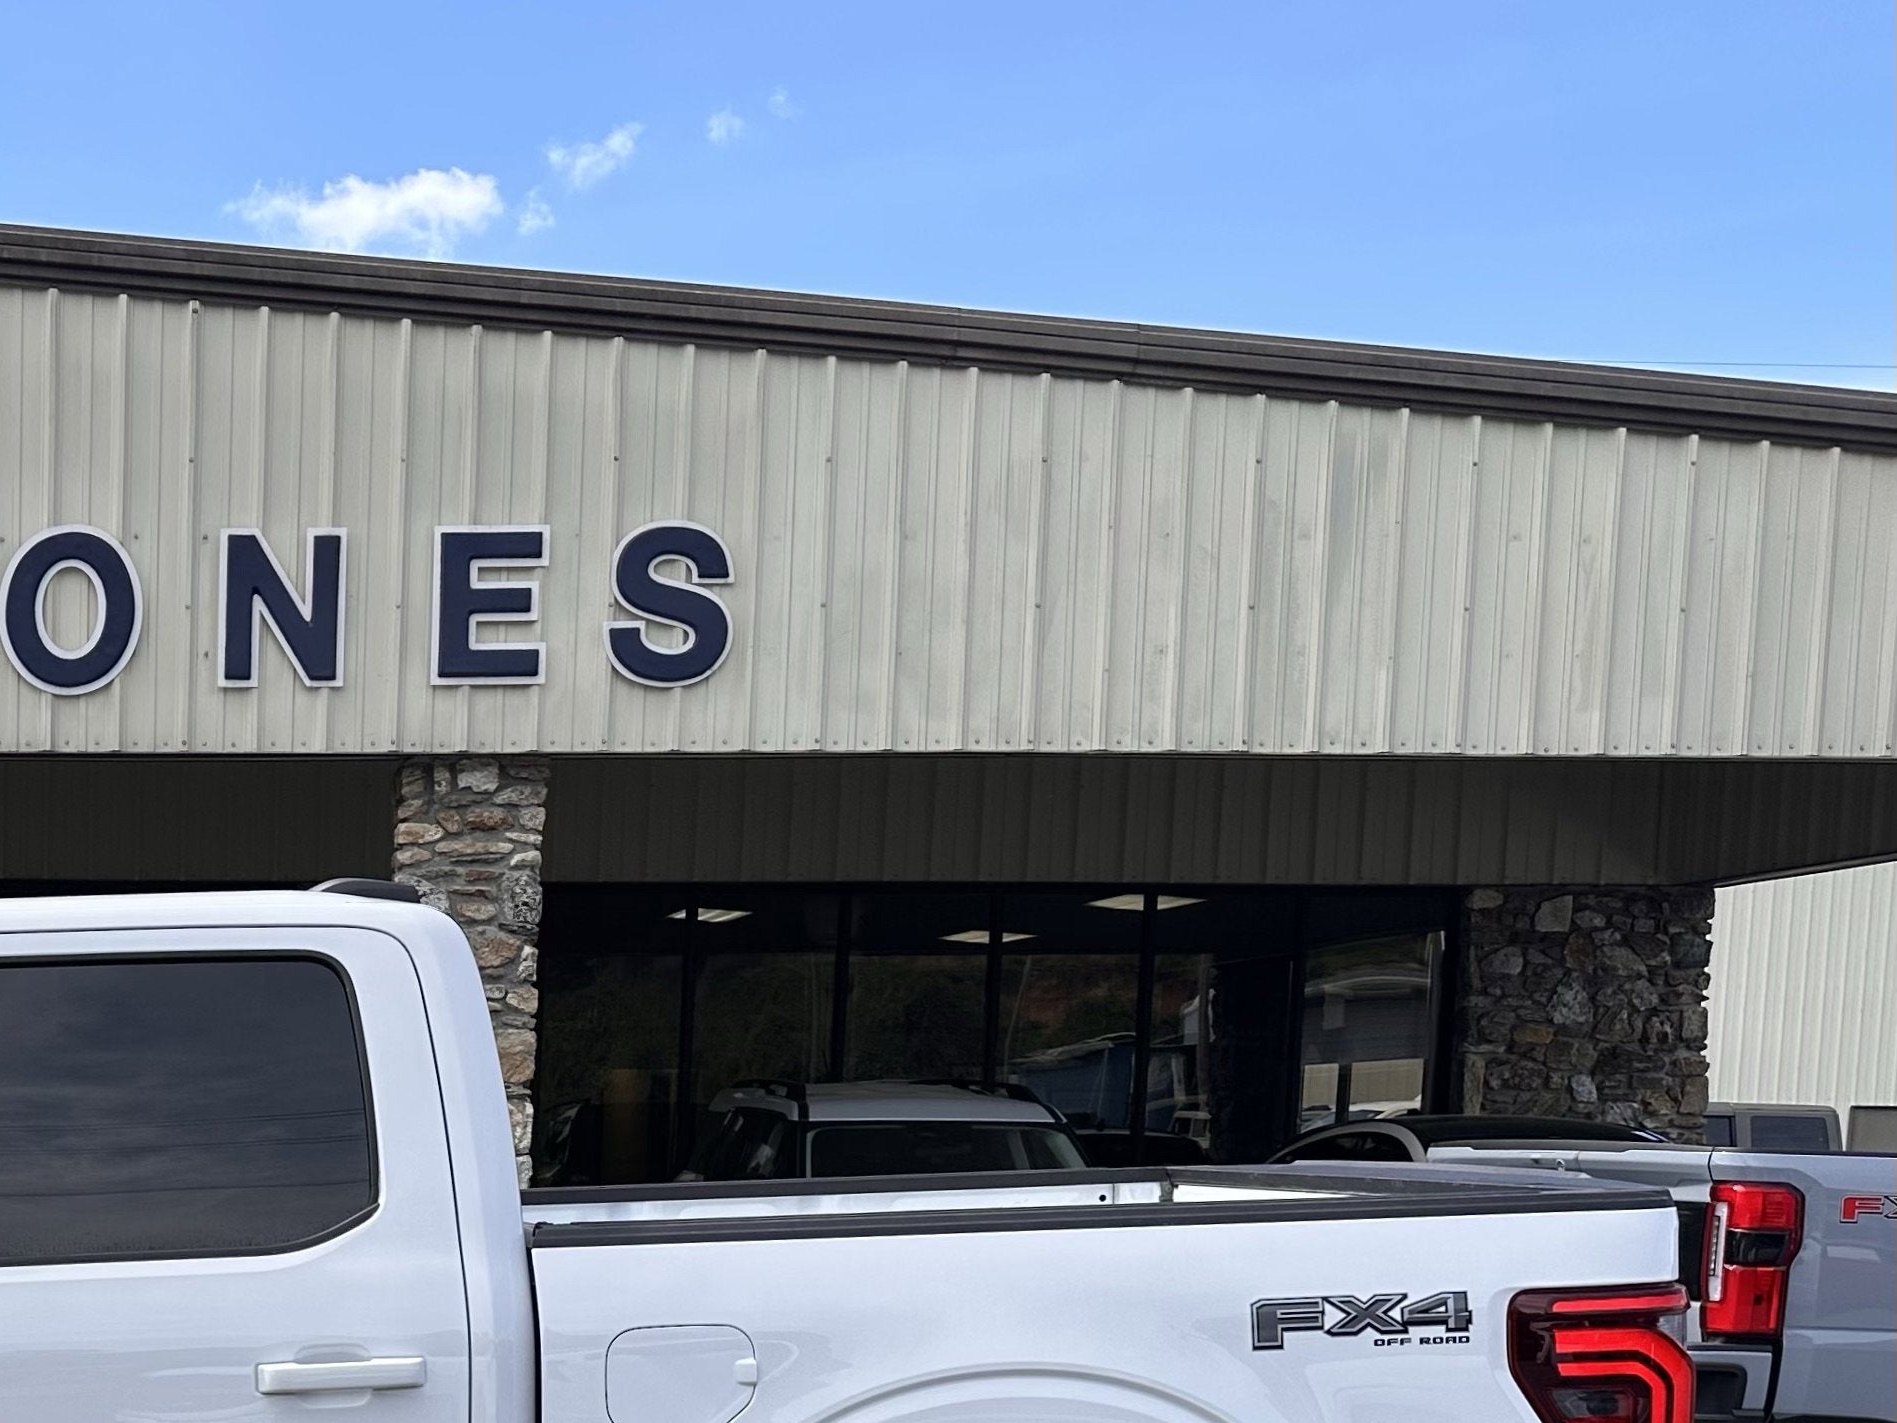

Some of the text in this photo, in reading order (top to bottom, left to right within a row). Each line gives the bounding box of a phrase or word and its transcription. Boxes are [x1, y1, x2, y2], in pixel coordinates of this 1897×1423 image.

[1250, 1290, 1473, 1351] FX4
[1373, 1335, 1471, 1347] OFF ROAD
